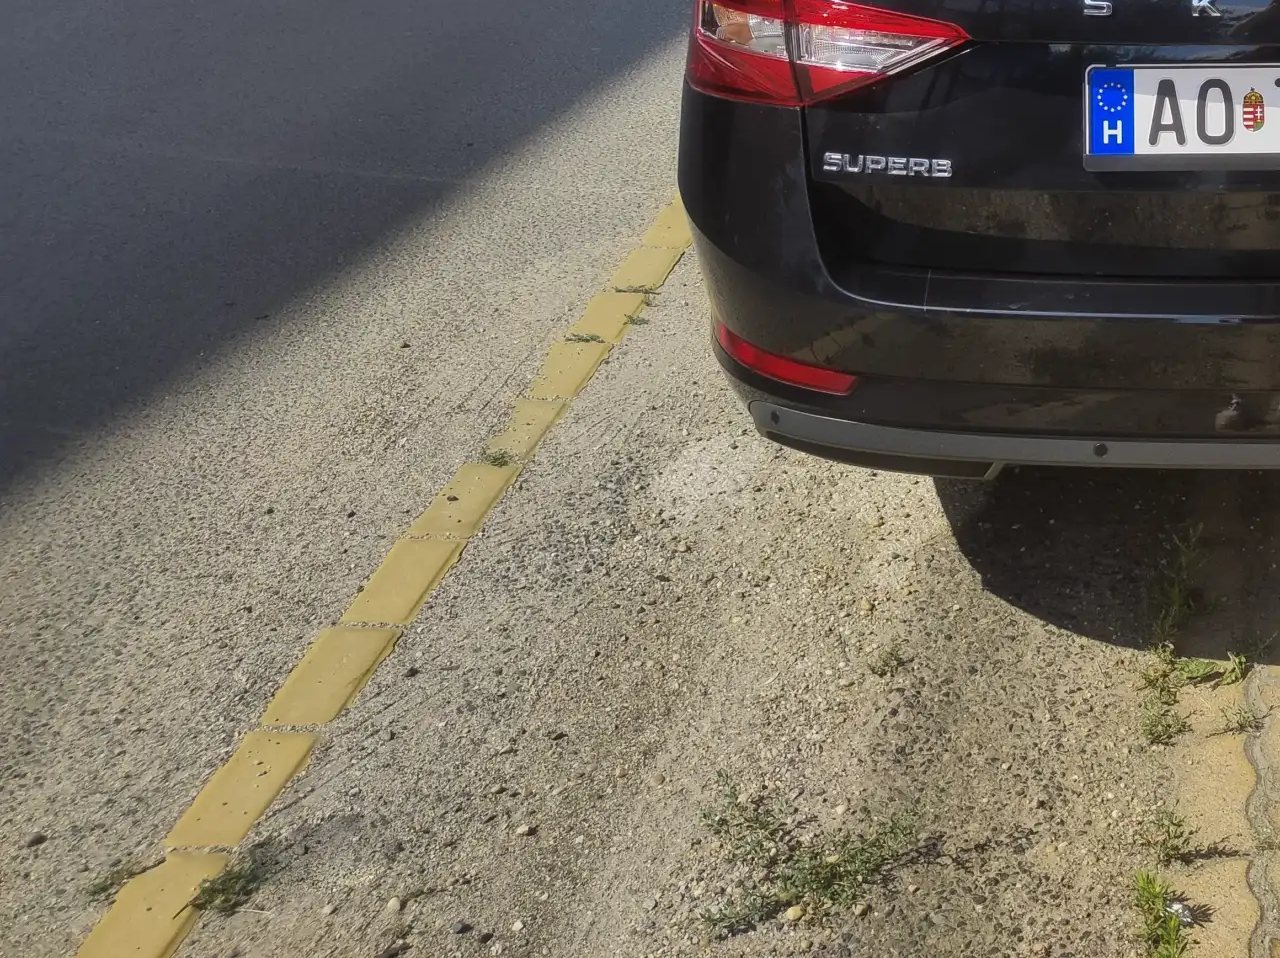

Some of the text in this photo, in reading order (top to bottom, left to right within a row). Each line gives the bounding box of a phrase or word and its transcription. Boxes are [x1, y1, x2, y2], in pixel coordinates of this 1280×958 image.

[1148, 78, 1235, 146] AO
[1102, 119, 1123, 145] H
[823, 152, 952, 177] SUPERB
